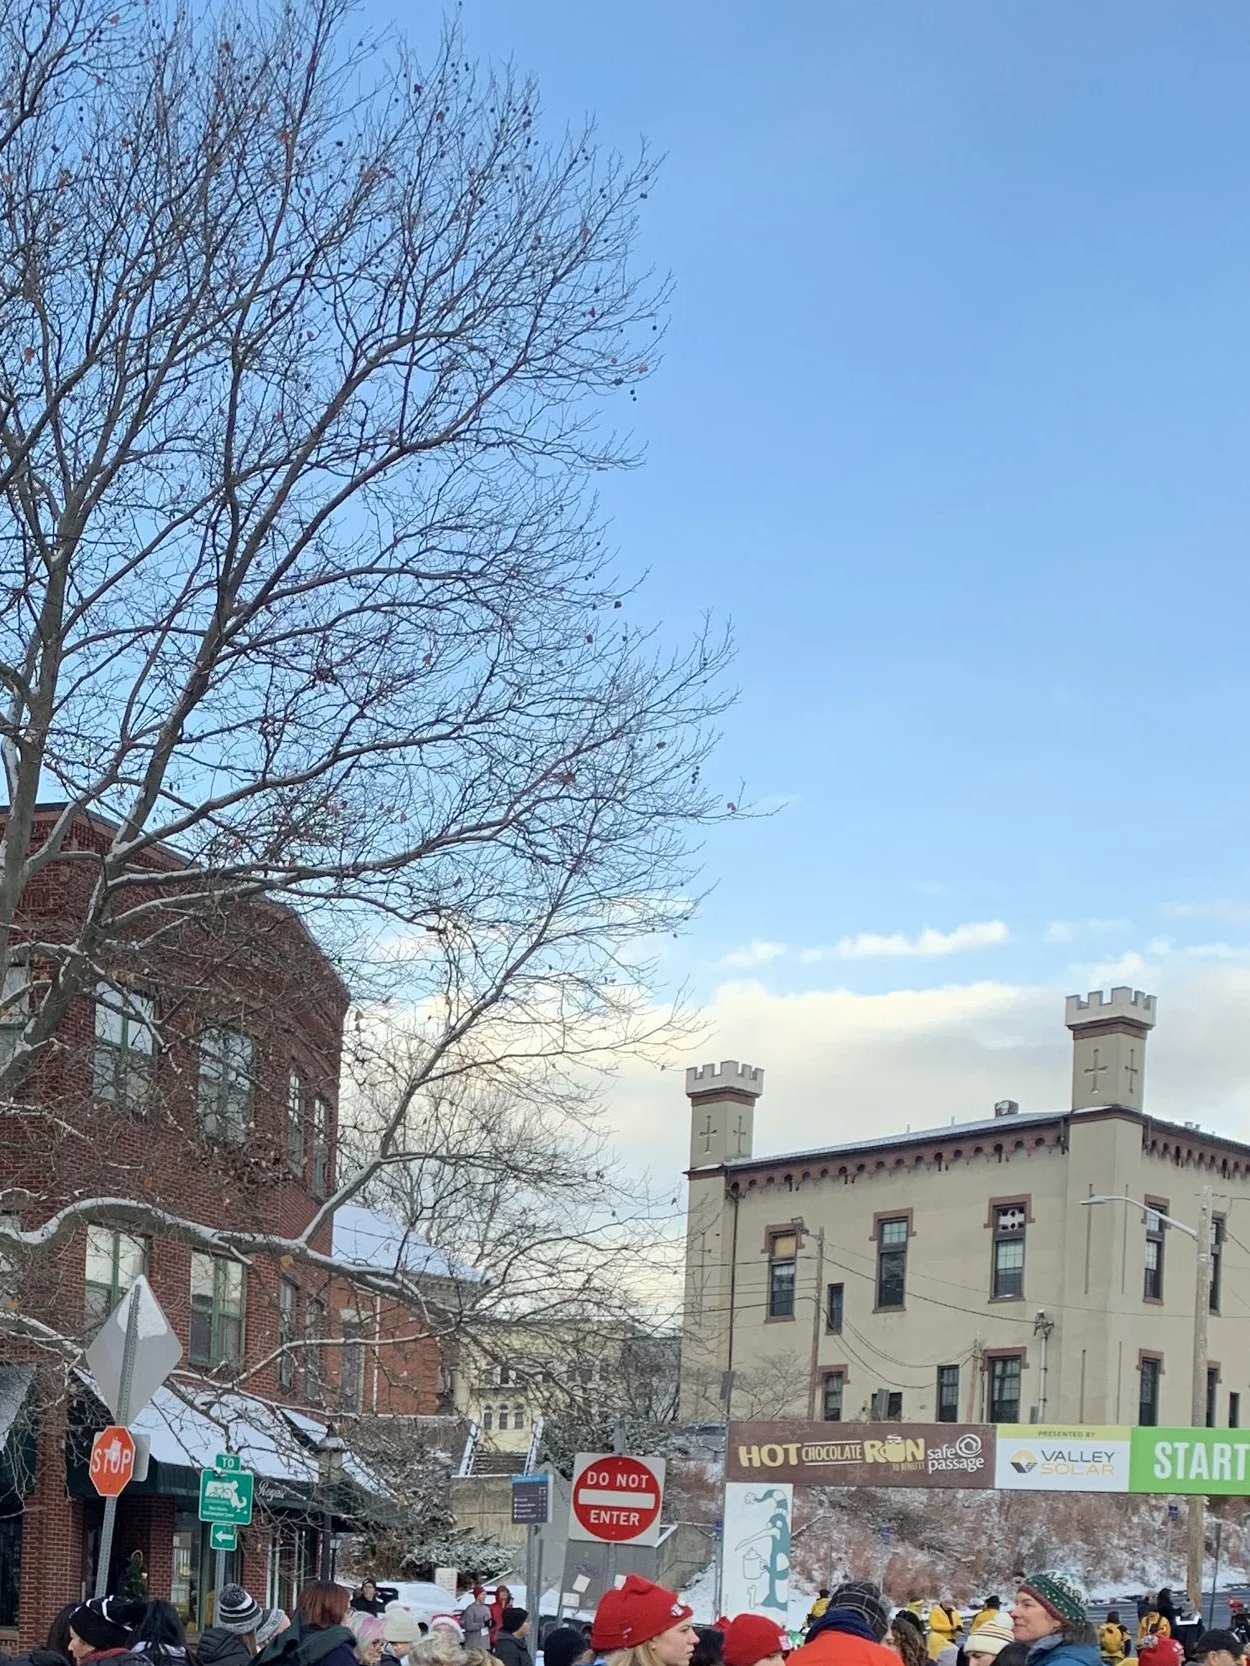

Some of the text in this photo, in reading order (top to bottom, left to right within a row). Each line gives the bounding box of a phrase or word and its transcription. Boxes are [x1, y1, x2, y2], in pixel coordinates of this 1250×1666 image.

[1038, 1430, 1084, 1438] PRESENTED
[738, 1443, 801, 1467] HOT
[803, 1445, 862, 1462] CHOCOLATE
[927, 1444, 956, 1459] safe
[1041, 1450, 1115, 1463] VALLEY
[92, 1448, 131, 1474] STOP
[222, 1457, 234, 1468] TO
[928, 1457, 984, 1474] passage
[1040, 1463, 1114, 1476] SOLAR
[1153, 1441, 1250, 1481] START
[587, 1471, 649, 1488] DO NOT
[590, 1509, 639, 1526] ENTER
